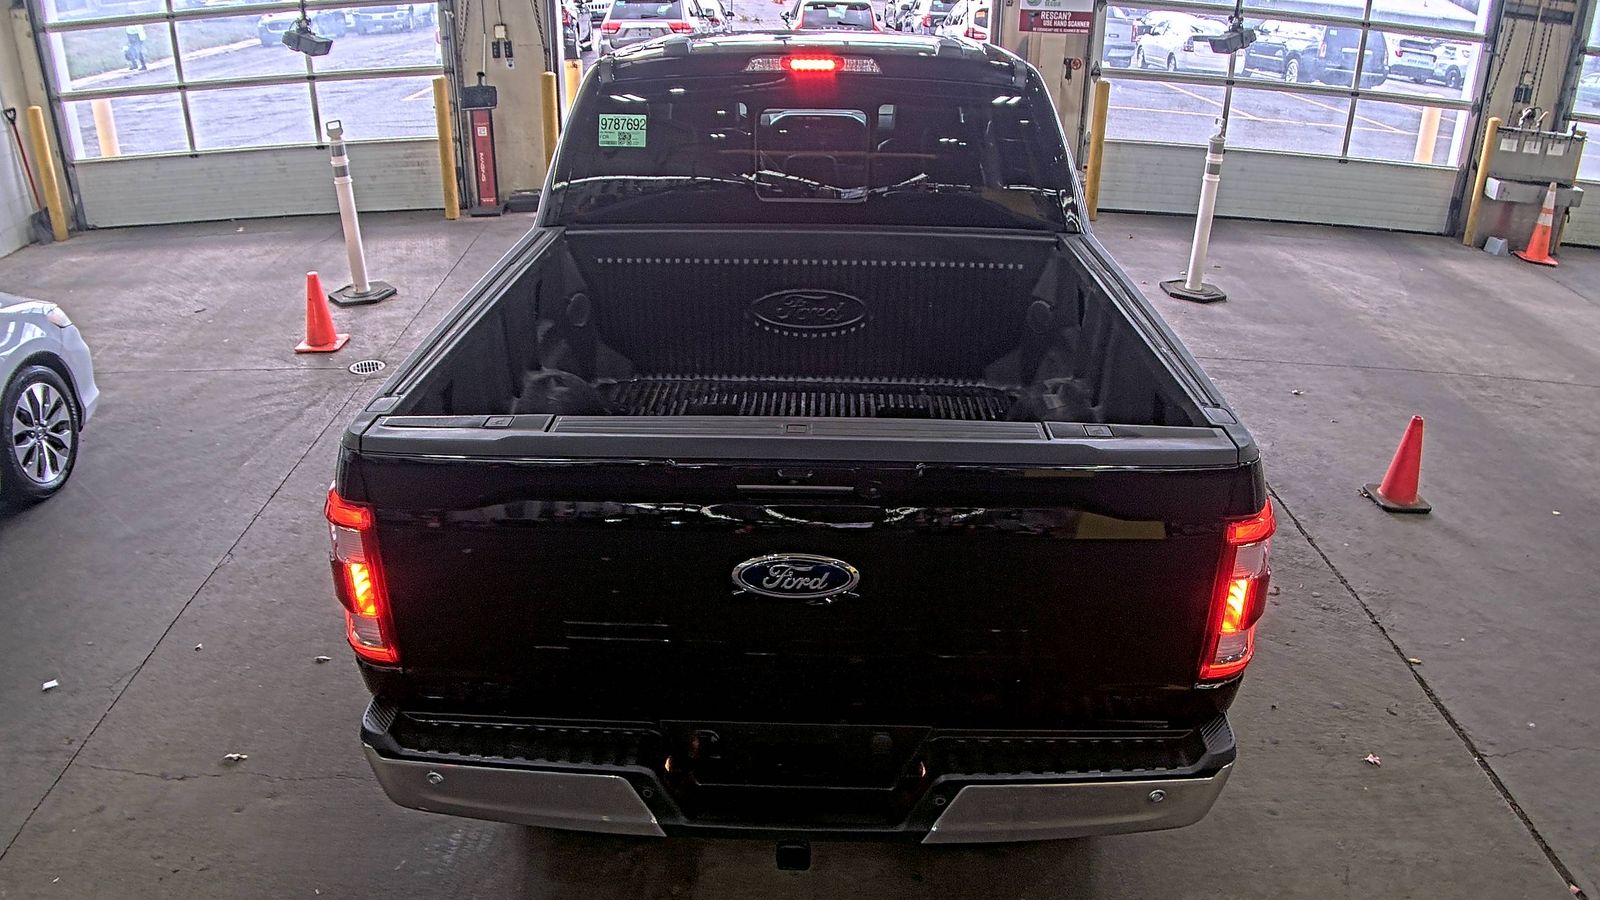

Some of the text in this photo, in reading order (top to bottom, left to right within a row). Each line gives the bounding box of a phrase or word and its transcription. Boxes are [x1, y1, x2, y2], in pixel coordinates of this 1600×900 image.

[1040, 11, 1072, 20] RESCAN?
[600, 118, 647, 130] 9787692
[776, 293, 845, 321] Ford
[762, 564, 830, 590] Ford
